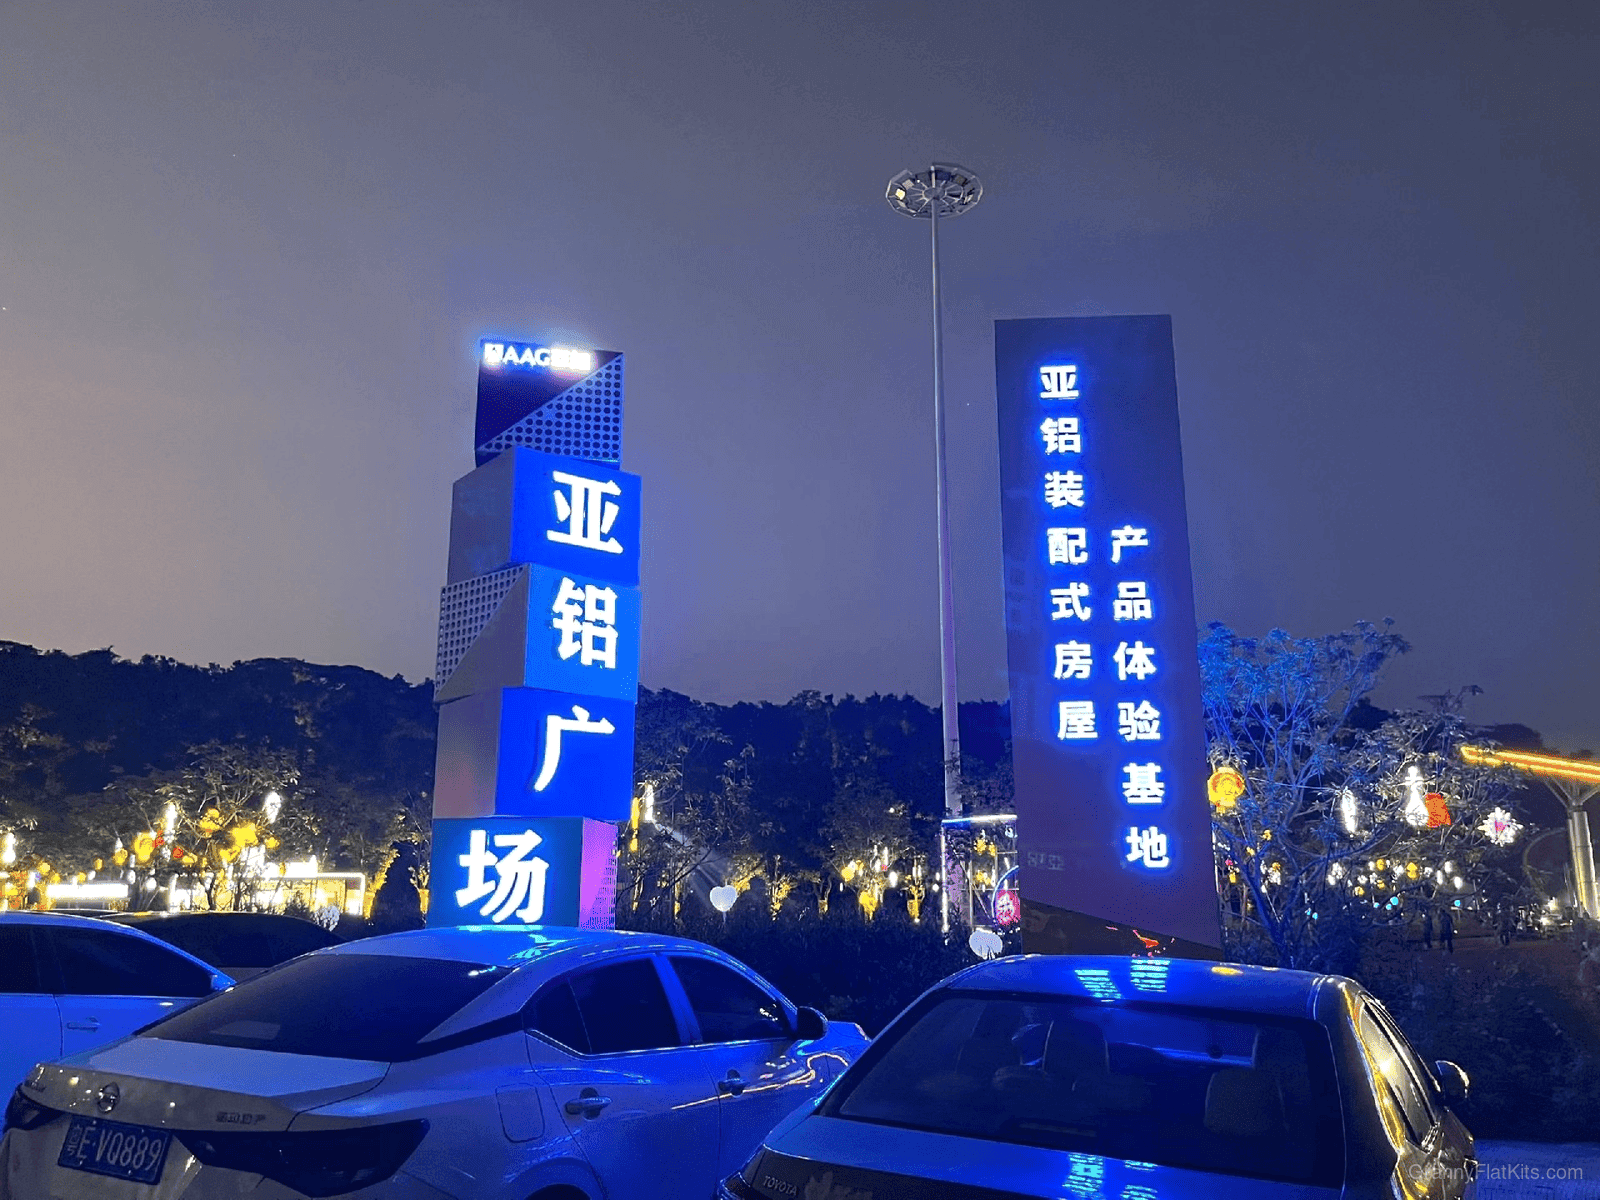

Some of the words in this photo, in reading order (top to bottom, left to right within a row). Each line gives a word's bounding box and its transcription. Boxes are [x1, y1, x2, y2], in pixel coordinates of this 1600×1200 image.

[455, 470, 624, 923] 亚铝广场
[1039, 365, 1098, 740] 亚铝装配式房屋
[1110, 525, 1170, 869] 产品体验基地
[763, 1175, 798, 1197] TOYOTA
